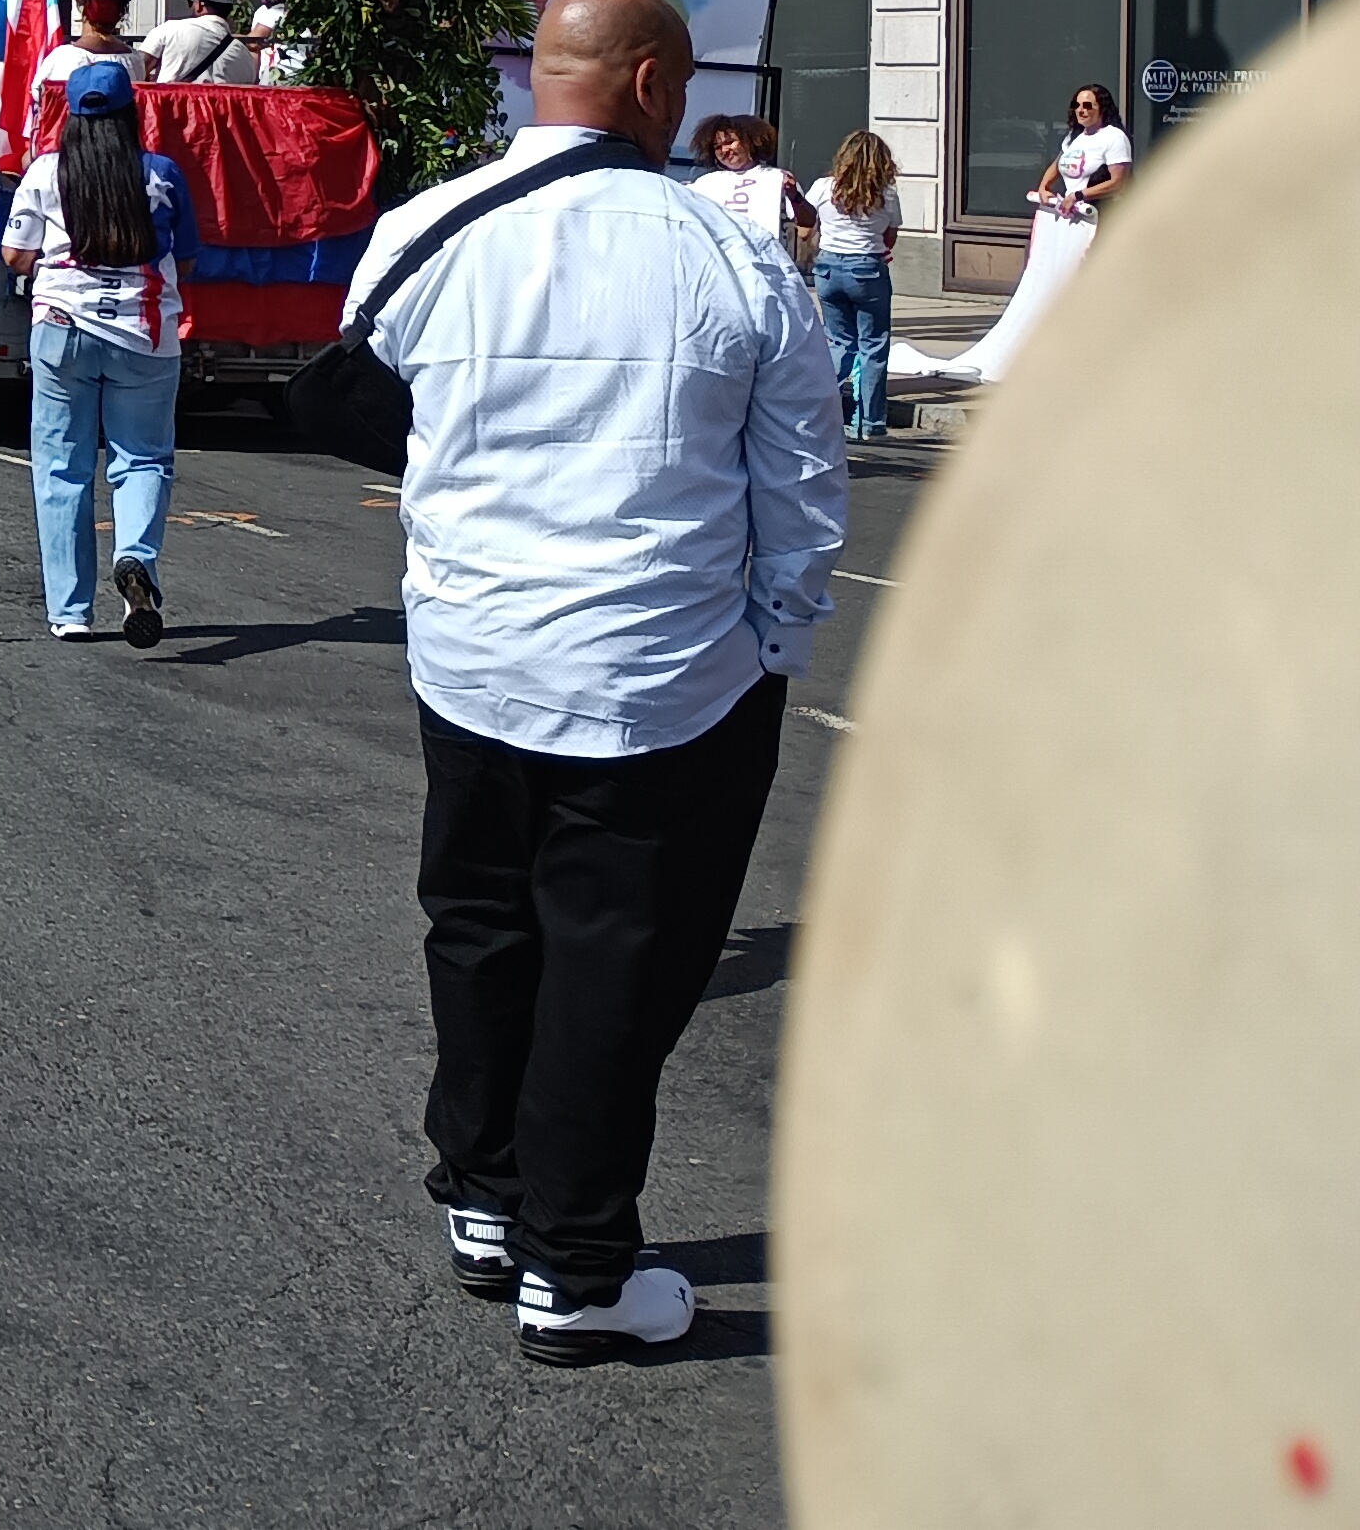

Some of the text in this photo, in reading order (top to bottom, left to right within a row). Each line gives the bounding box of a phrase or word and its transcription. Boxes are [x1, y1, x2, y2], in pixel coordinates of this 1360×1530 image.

[1180, 82, 1189, 93] &
[96, 277, 122, 320] RICO
[466, 1221, 505, 1240] PUMA
[519, 1285, 553, 1309] PUMA
